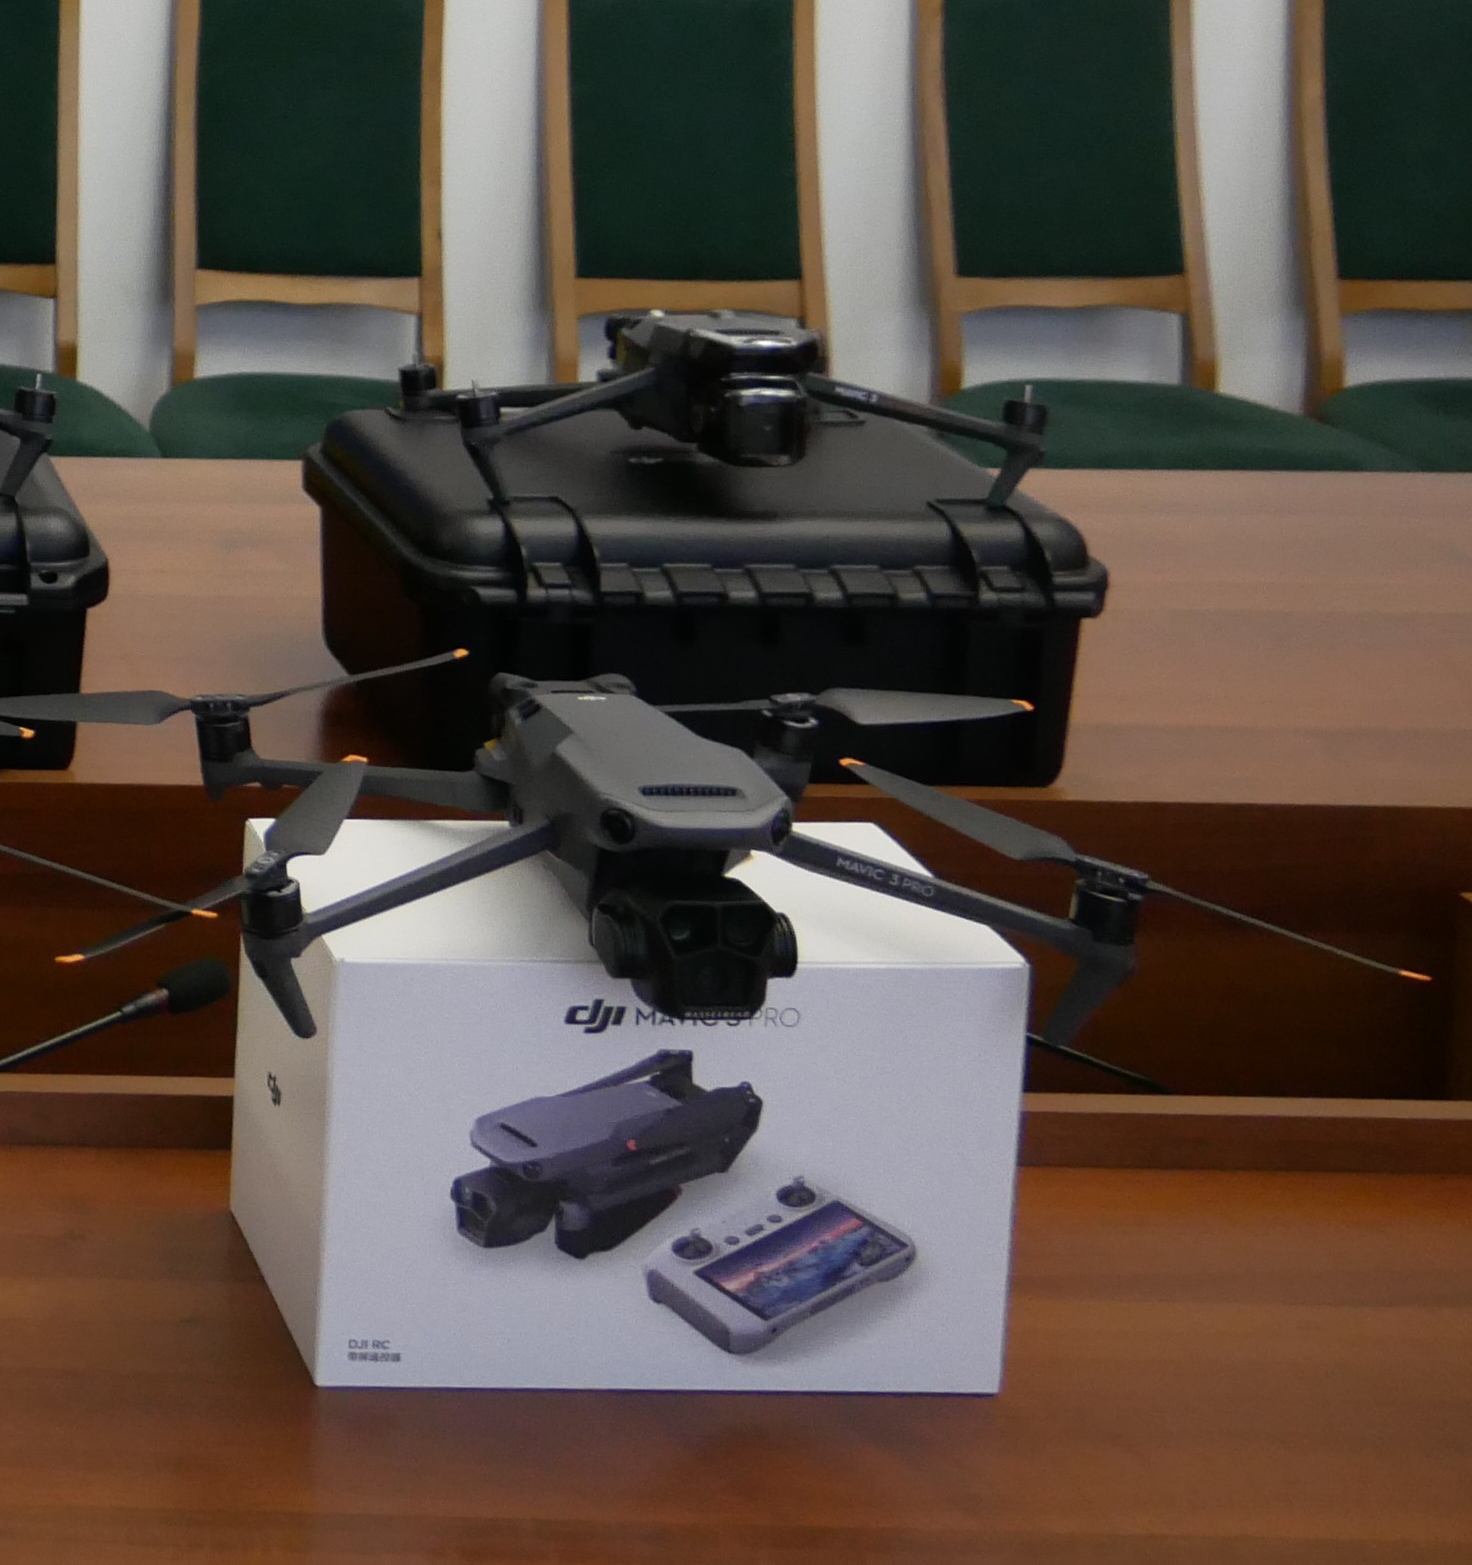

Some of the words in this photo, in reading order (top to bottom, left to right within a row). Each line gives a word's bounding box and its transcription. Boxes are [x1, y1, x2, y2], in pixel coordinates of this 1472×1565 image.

[836, 857, 886, 881] MAVIC
[901, 877, 935, 897] PRO
[348, 1339, 368, 1349] DJI
[371, 1339, 390, 1350] RC
